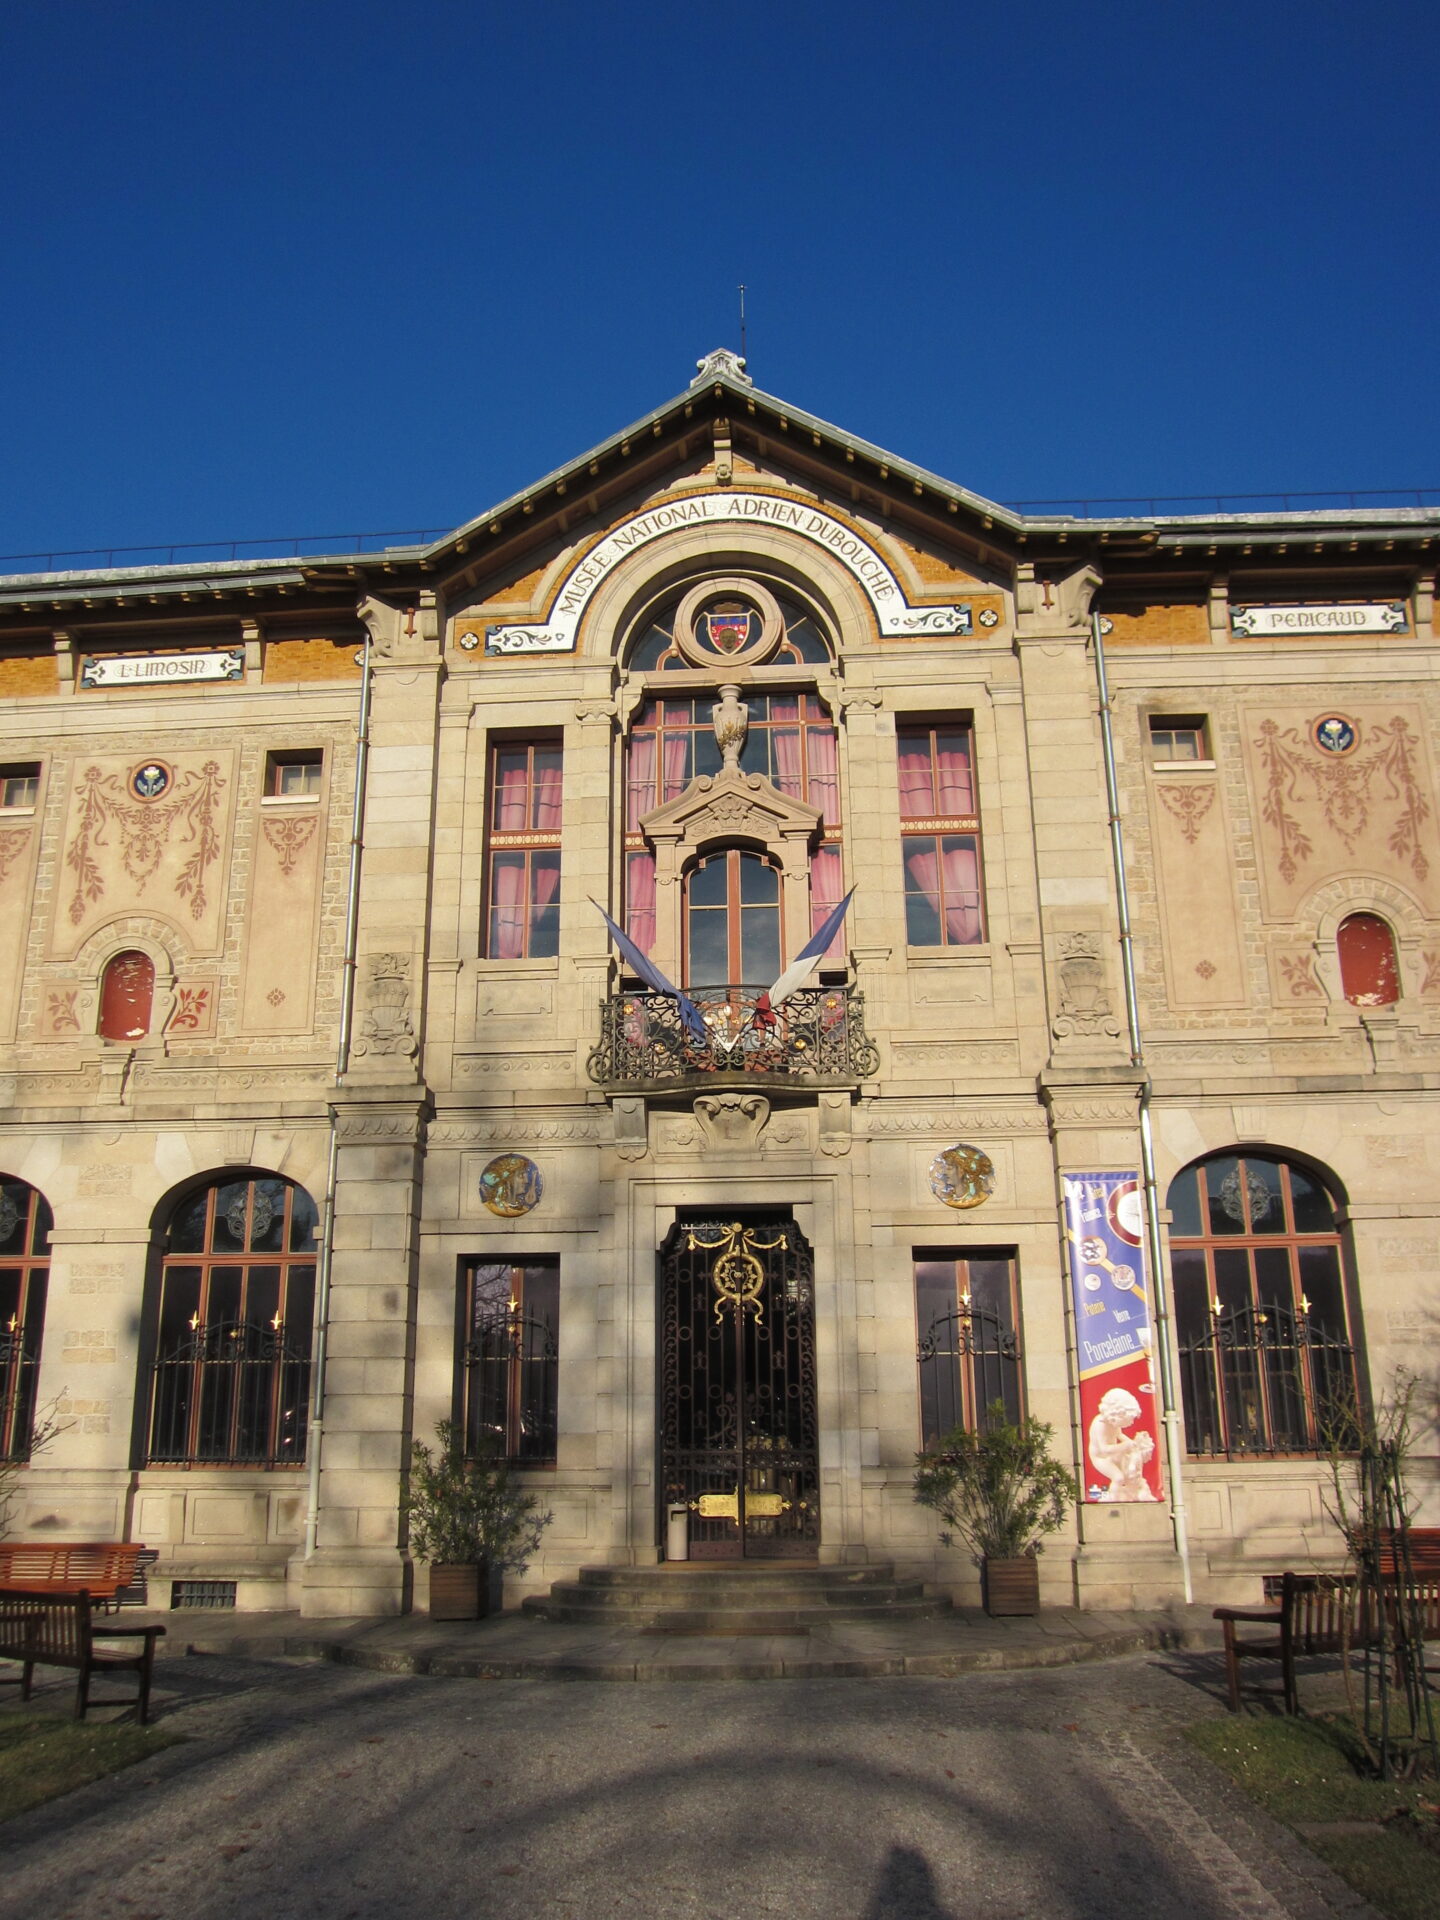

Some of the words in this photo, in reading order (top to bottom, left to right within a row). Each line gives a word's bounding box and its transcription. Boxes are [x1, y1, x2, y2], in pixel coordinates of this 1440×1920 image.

[558, 551, 611, 614] MUSÉE
[612, 501, 715, 552] NATIONAL
[728, 498, 803, 526] ADRIEN
[806, 515, 895, 602] DUBOUCHÉ
[1271, 611, 1366, 628] PENICAUD
[1083, 1332, 1135, 1364] Porcelaine
